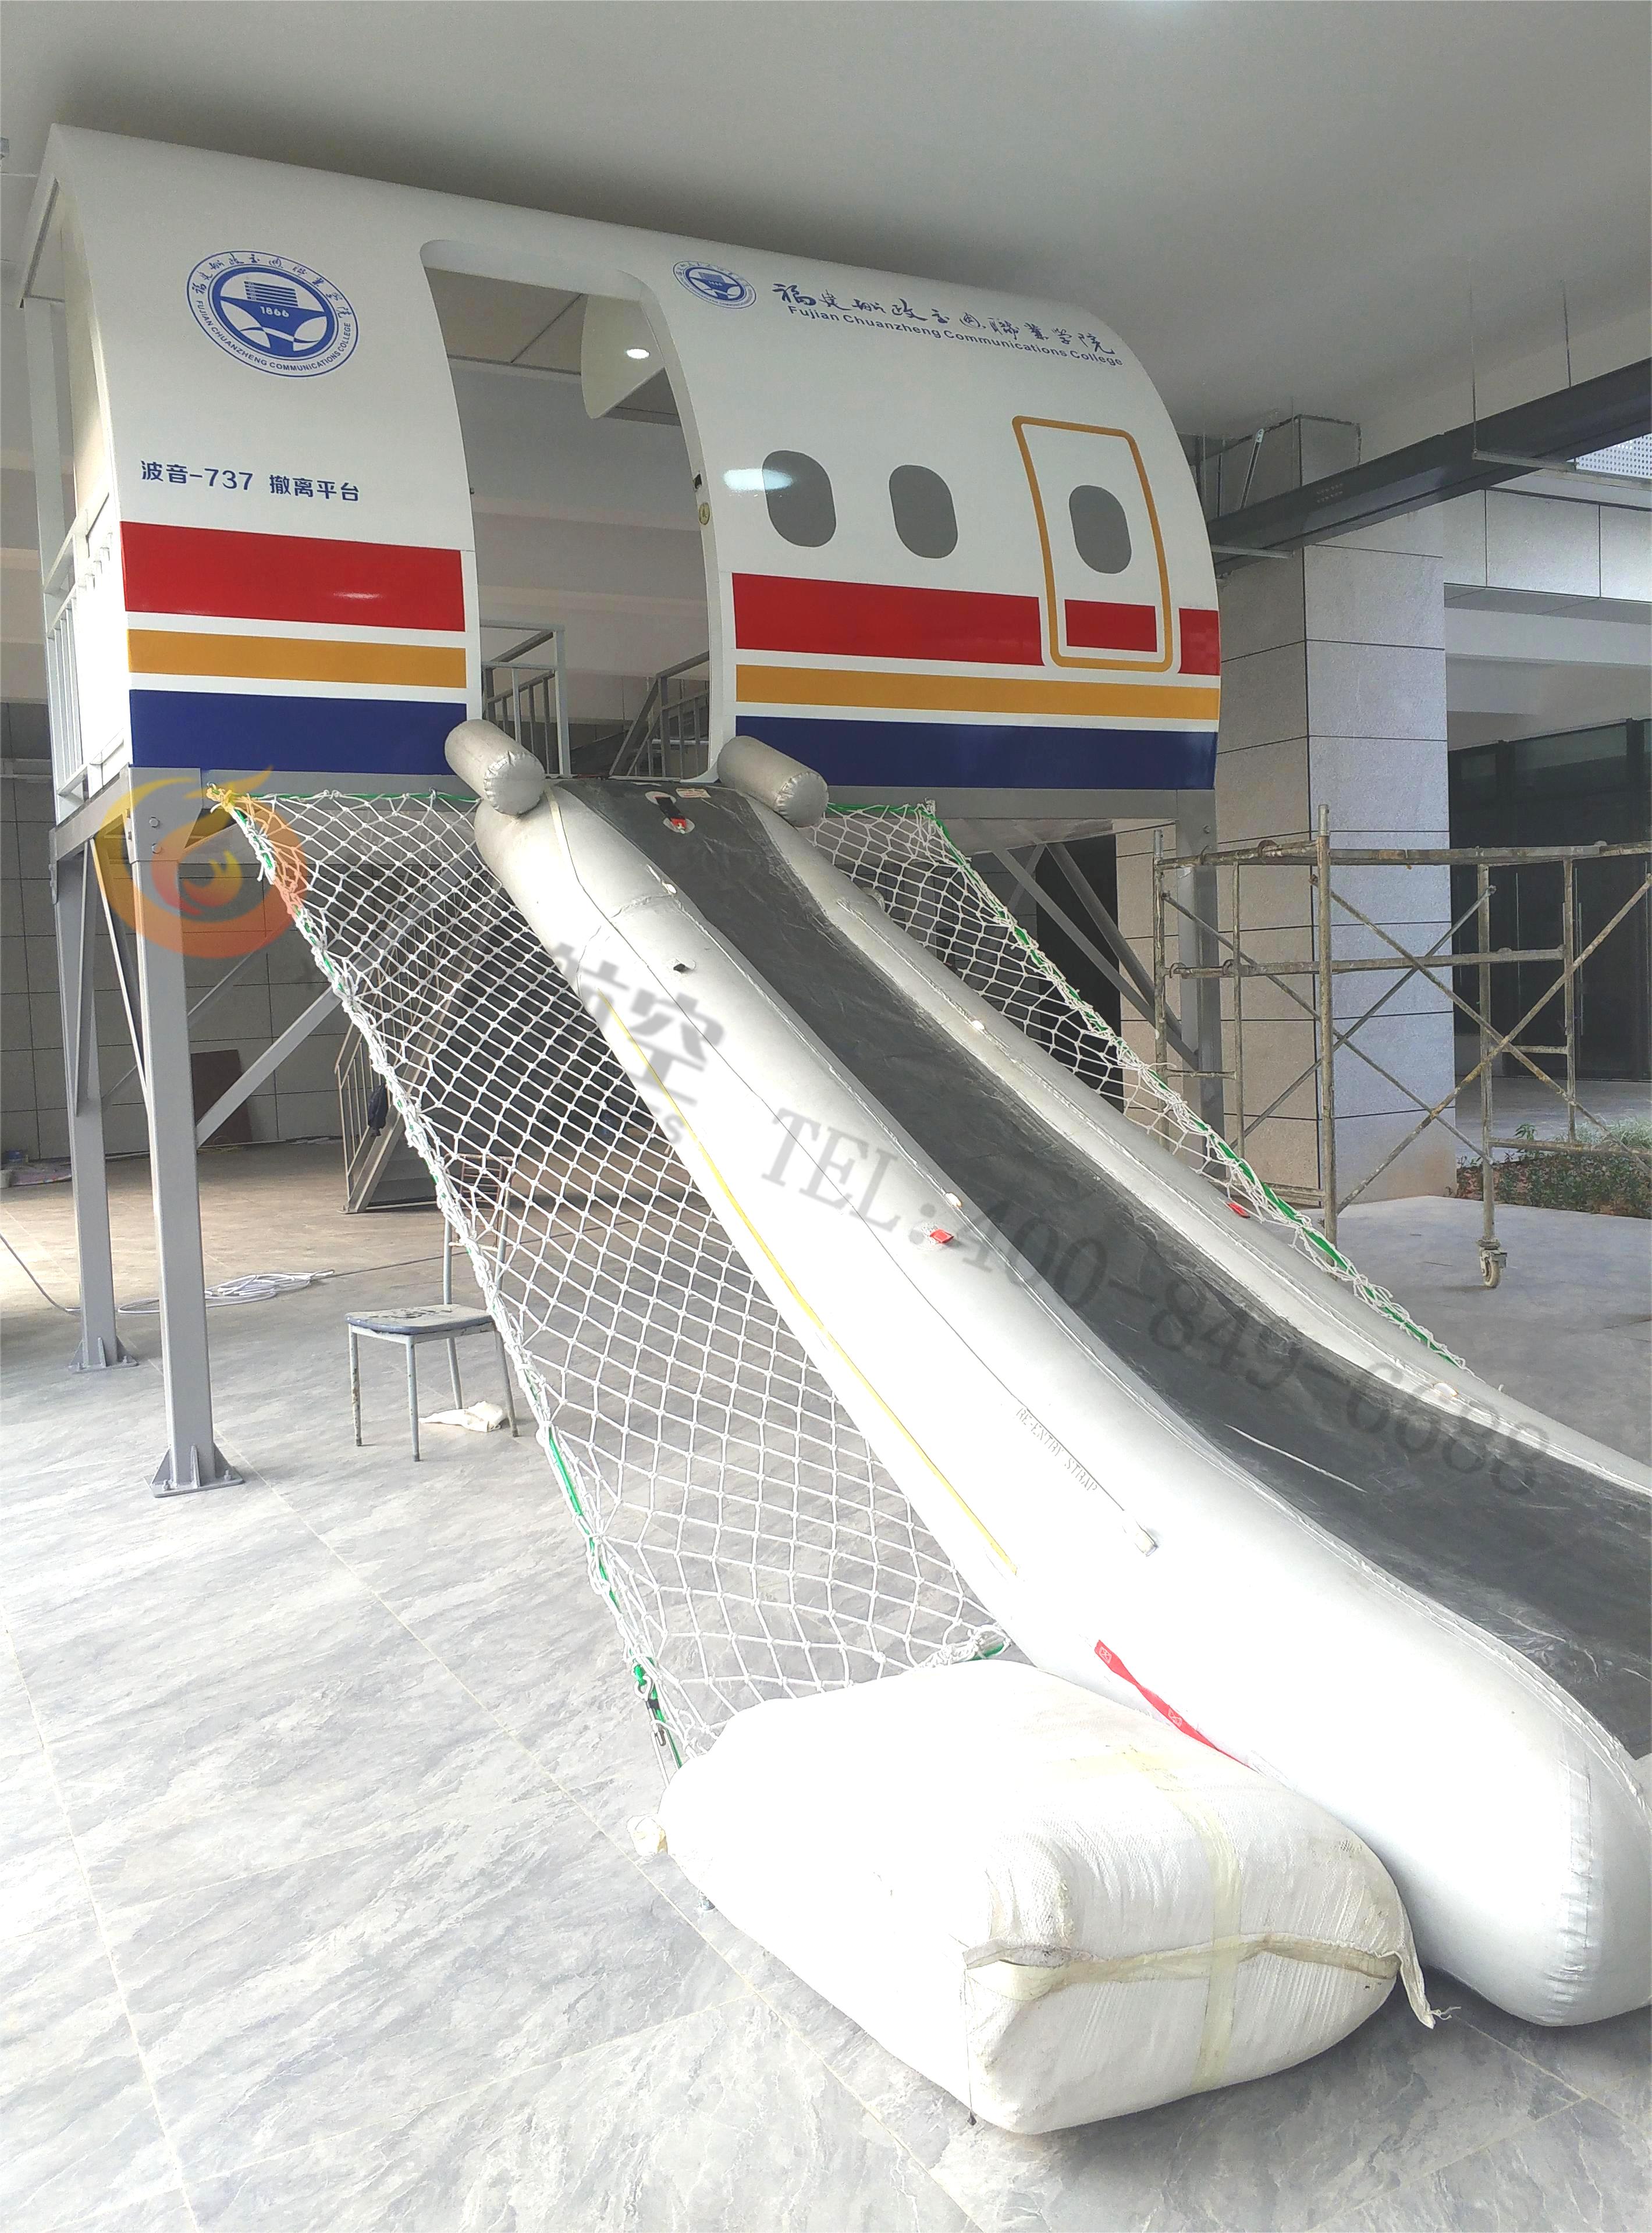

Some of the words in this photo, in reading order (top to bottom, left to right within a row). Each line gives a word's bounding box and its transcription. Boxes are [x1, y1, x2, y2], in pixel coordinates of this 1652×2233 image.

[196, 300, 214, 326] FUJIAN
[211, 326, 268, 366] CHUANZHENG
[269, 350, 341, 371] COMMUNICATIONS
[337, 322, 351, 353] COLLEGE
[260, 306, 290, 318] 1866
[787, 305, 839, 321] Fujian
[843, 314, 942, 339] Chuanzheng
[944, 329, 1067, 357] Communications
[1070, 349, 1122, 366] College
[140, 460, 254, 491] 波音-737
[269, 474, 360, 502] 撤离平台
[1016, 1407, 1064, 1456] RE-ENTRY
[1064, 1457, 1098, 1491] STRAP
